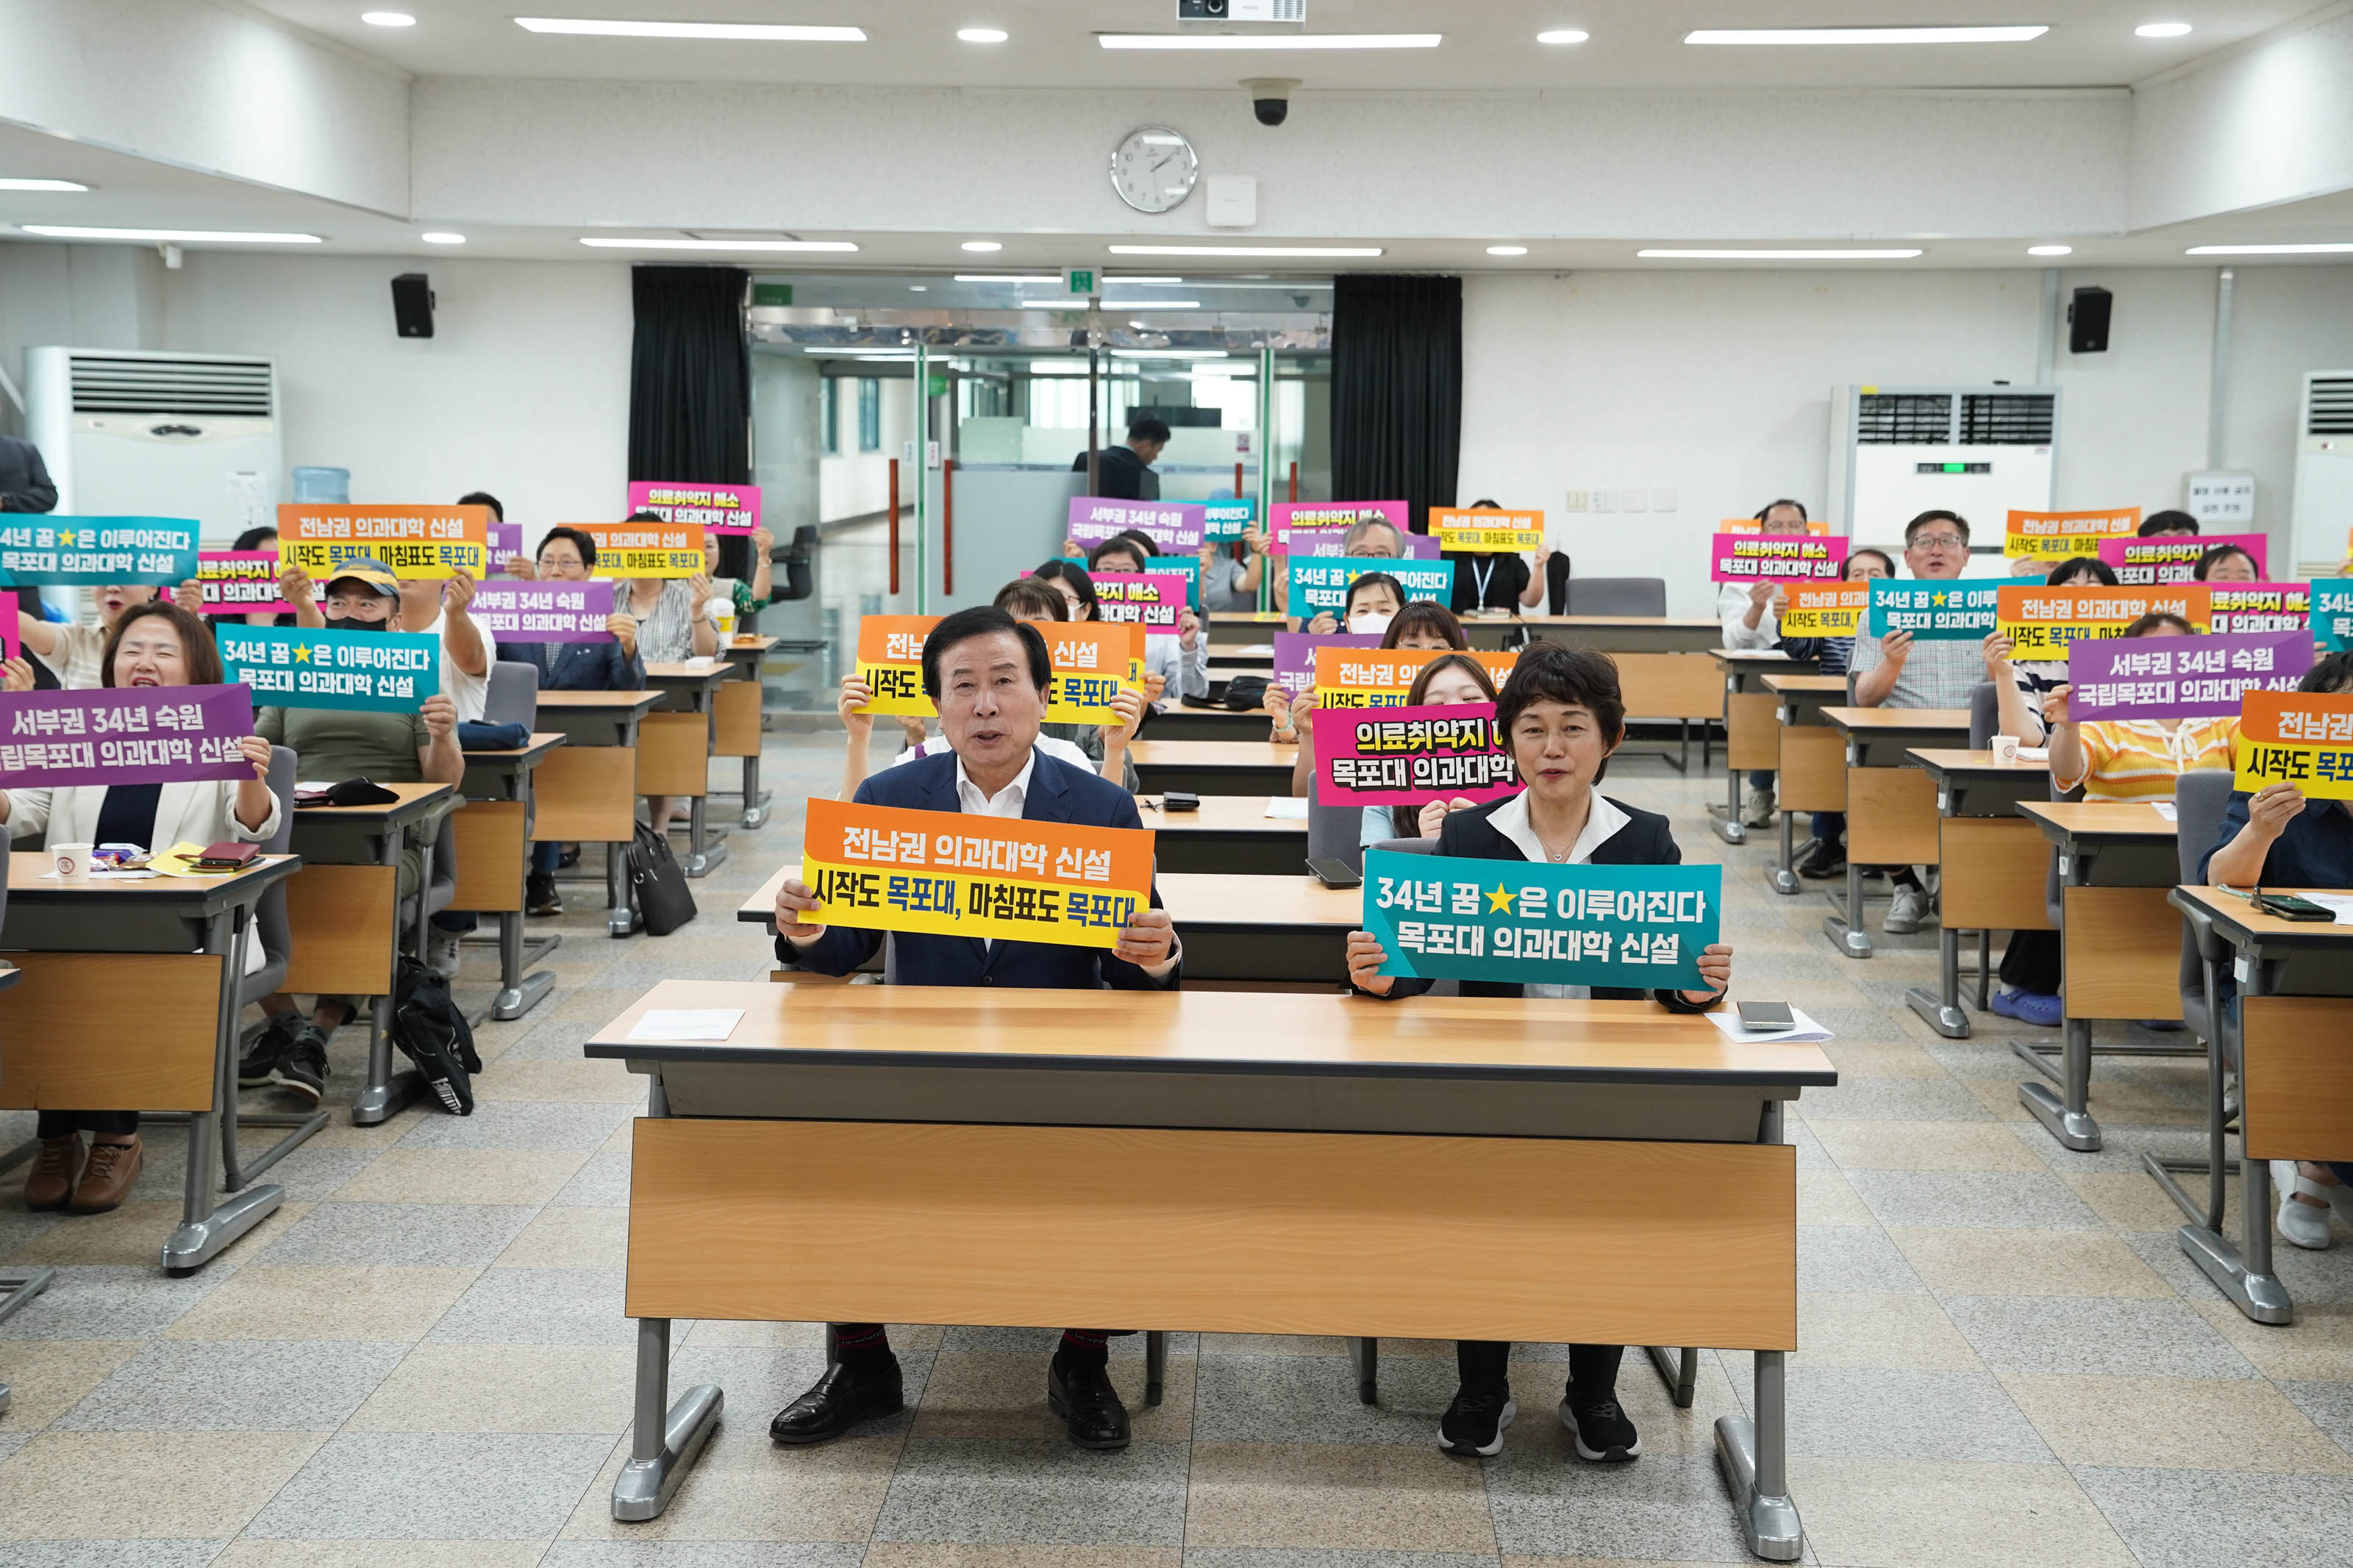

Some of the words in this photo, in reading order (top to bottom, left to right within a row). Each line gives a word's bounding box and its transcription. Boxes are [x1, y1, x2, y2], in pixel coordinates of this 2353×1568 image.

[649, 489, 711, 506] 의료취약지
[714, 493, 740, 509] 해소
[675, 507, 724, 526] 의과대학
[726, 512, 752, 527] 신설
[1090, 507, 1126, 523] 서부권
[1129, 509, 1157, 525] 34년
[1158, 512, 1182, 527] 숙원
[1290, 509, 1356, 527] 의료취약지
[1442, 515, 1471, 529] 전남권
[1472, 516, 1510, 529] 의과대학
[1512, 516, 1532, 529] 신설
[2023, 519, 2058, 534] 전남권
[2060, 518, 2108, 534] 의과대학
[2110, 516, 2131, 533] 신설
[300, 517, 351, 538] 전남권
[355, 517, 425, 538] 의과대학
[430, 518, 463, 538] 신설
[0, 528, 31, 547] 4년
[36, 528, 54, 548] 꿈
[77, 529, 96, 548] 은
[100, 529, 190, 551] 이루어진다
[610, 532, 659, 548] 의과대학
[663, 533, 687, 548] 신설
[1176, 530, 1199, 546] 신설
[1484, 532, 1514, 545] 마침표도
[1517, 532, 1539, 545] 목포대
[2010, 537, 2038, 552] 시작도
[285, 545, 325, 566] 시작도
[380, 546, 435, 566] 마침표도
[440, 546, 479, 567] 목포대
[1733, 541, 1799, 558] 의료취약지
[1802, 543, 1828, 559] 해소
[2124, 544, 2204, 564] 의료취약지
[2, 552, 57, 572] 목포대
[61, 553, 134, 573] 의과대학
[138, 554, 174, 573] 신설
[627, 554, 666, 569] 마침표도
[670, 554, 698, 569] 목포대
[1720, 558, 1758, 576] 목포대
[1760, 559, 1812, 577] 의과대학
[1815, 561, 1839, 577] 신설
[1294, 568, 1327, 586] 34년
[1329, 569, 1344, 586] 꿈
[1382, 570, 1447, 590] 루어진다
[473, 592, 515, 610] 서부권
[519, 592, 553, 610] 34년
[557, 592, 585, 610] 숙원
[1127, 582, 1160, 601] 해소
[1305, 589, 1346, 607] 목포대
[1799, 591, 1837, 608] 전남권
[1876, 590, 1910, 608] 34년
[1914, 590, 1929, 609] 꿈
[1948, 591, 1963, 608] 은
[2210, 591, 2282, 611] 료취약지
[1144, 605, 1175, 624] 신설
[2022, 599, 2072, 619] 전남권
[2077, 599, 2147, 619] 의과대학
[523, 614, 576, 631] 의과대학
[580, 615, 607, 631] 신설
[1787, 612, 1817, 628] 시작도
[1820, 612, 1854, 629] 목포대,
[1887, 612, 1930, 629] 목포대
[1935, 612, 1996, 629] 의과대학
[2232, 615, 2301, 633] 의과대학
[224, 640, 265, 664] 34년
[271, 642, 290, 665] 꿈
[313, 645, 332, 667] 은
[338, 645, 429, 670] 이루어진다
[886, 633, 926, 659] 전남
[1054, 640, 1098, 668] 신설
[2110, 652, 2171, 676] 서부권
[2177, 650, 2226, 674] 34년
[2232, 647, 2274, 671] 숙원
[238, 668, 293, 692] 목포대
[299, 672, 372, 695] 의과대학
[377, 676, 413, 698] 신설
[1340, 663, 1393, 686] 전남권
[865, 669, 915, 698] 시작도
[1064, 679, 1118, 707] 목포대
[2078, 681, 2175, 706] 국립목포대
[13, 709, 86, 736] 서부권
[91, 706, 149, 733] 34년
[155, 704, 204, 731] 숙원
[2278, 712, 2353, 741] 전남권
[1357, 718, 1485, 753] 의료취약지
[0, 742, 95, 770] 립목포대
[101, 739, 193, 767] 의과대학
[199, 737, 245, 763] 신설
[1332, 759, 1407, 788] 목포대
[1413, 755, 1514, 787] 의과대학
[2247, 748, 2310, 780] 시작도
[2316, 752, 2353, 782] 목포
[843, 826, 926, 864] 전남권
[935, 835, 1047, 875] 의과대학
[1055, 847, 1112, 881] 신설
[812, 869, 880, 907] 시작도
[887, 875, 961, 920] 목포대,
[969, 882, 1060, 923] 마침표도
[1067, 892, 1135, 928] 목포대
[1376, 877, 1442, 913] 34년
[1452, 883, 1480, 915] 꿈
[1518, 886, 1548, 918] 은
[1557, 889, 1706, 923] 이루어진다
[1398, 921, 1484, 957] 목포대
[1493, 927, 1613, 962] 의과대학
[1621, 931, 1679, 964] 신설
